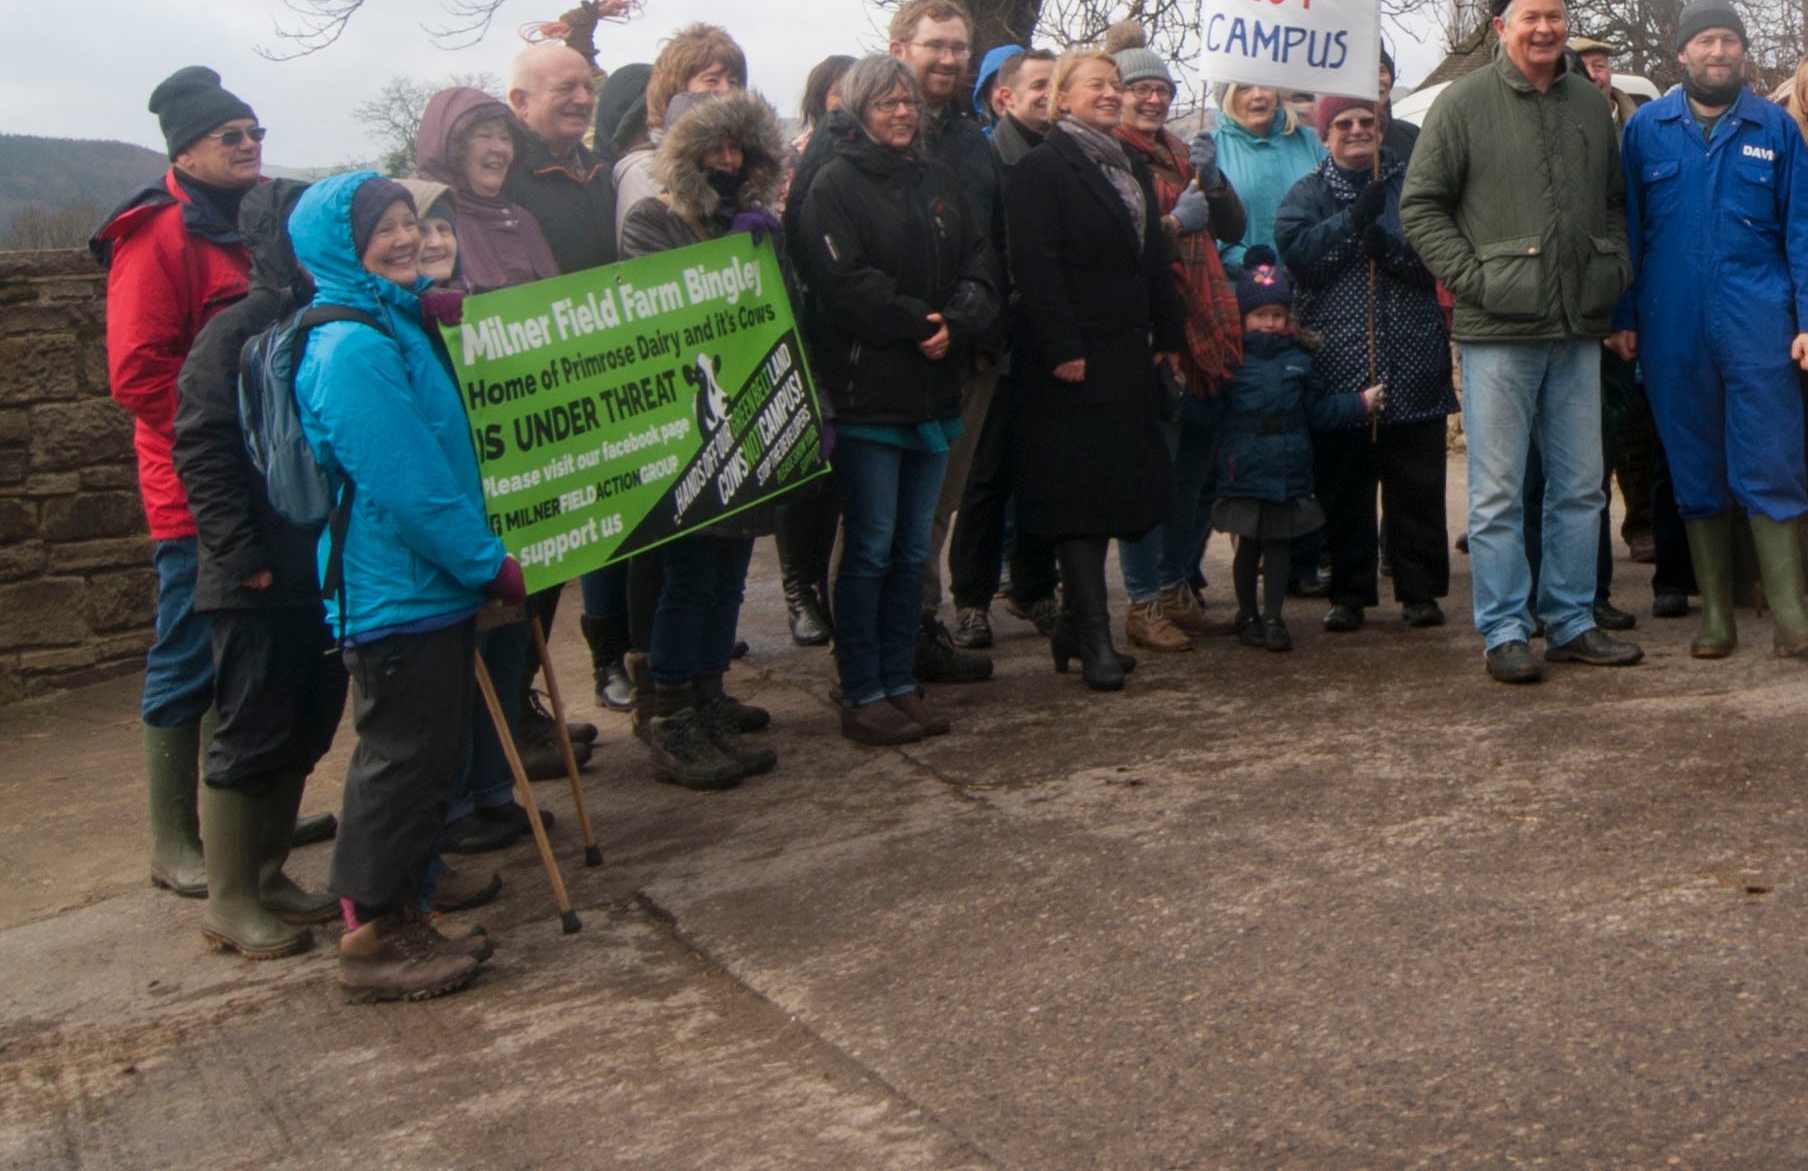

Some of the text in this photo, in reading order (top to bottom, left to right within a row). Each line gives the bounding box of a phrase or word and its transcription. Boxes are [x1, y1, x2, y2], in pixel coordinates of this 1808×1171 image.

[1207, 13, 1348, 69] CAMPUS
[461, 256, 762, 366] Milner Field Farm Bingley
[467, 303, 776, 411] Home of Primrose Dairy and it's Cows
[513, 396, 601, 453] UNDER
[600, 368, 677, 423] THREAT
[543, 454, 575, 481] visit
[577, 449, 600, 471] our
[602, 426, 661, 462] facebook
[661, 418, 690, 444] page
[674, 459, 707, 516] HANDS
[702, 440, 719, 479] OFF
[715, 421, 735, 460] OUR
[765, 342, 792, 387] LAND
[519, 513, 624, 567] support us
